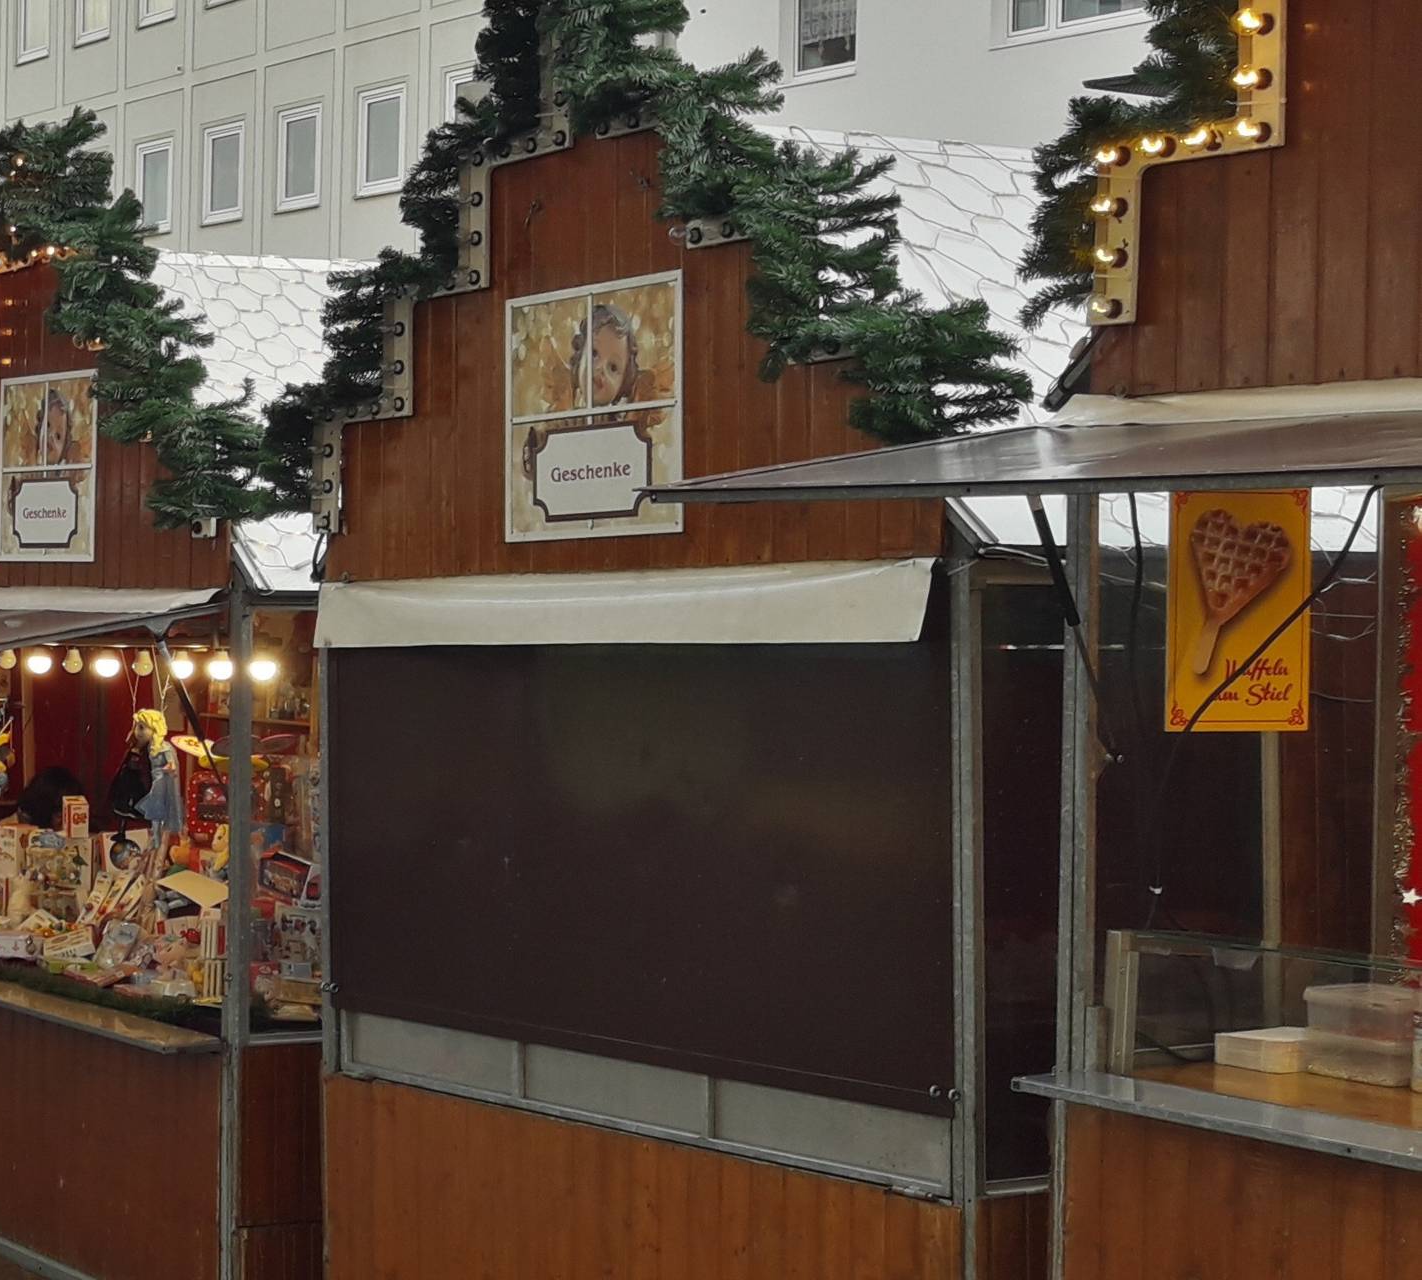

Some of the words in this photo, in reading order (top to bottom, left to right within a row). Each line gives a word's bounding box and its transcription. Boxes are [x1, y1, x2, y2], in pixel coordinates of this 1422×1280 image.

[551, 461, 632, 483] Geschenke
[22, 507, 67, 519] Geschenke
[1244, 681, 1294, 706] Stiel
